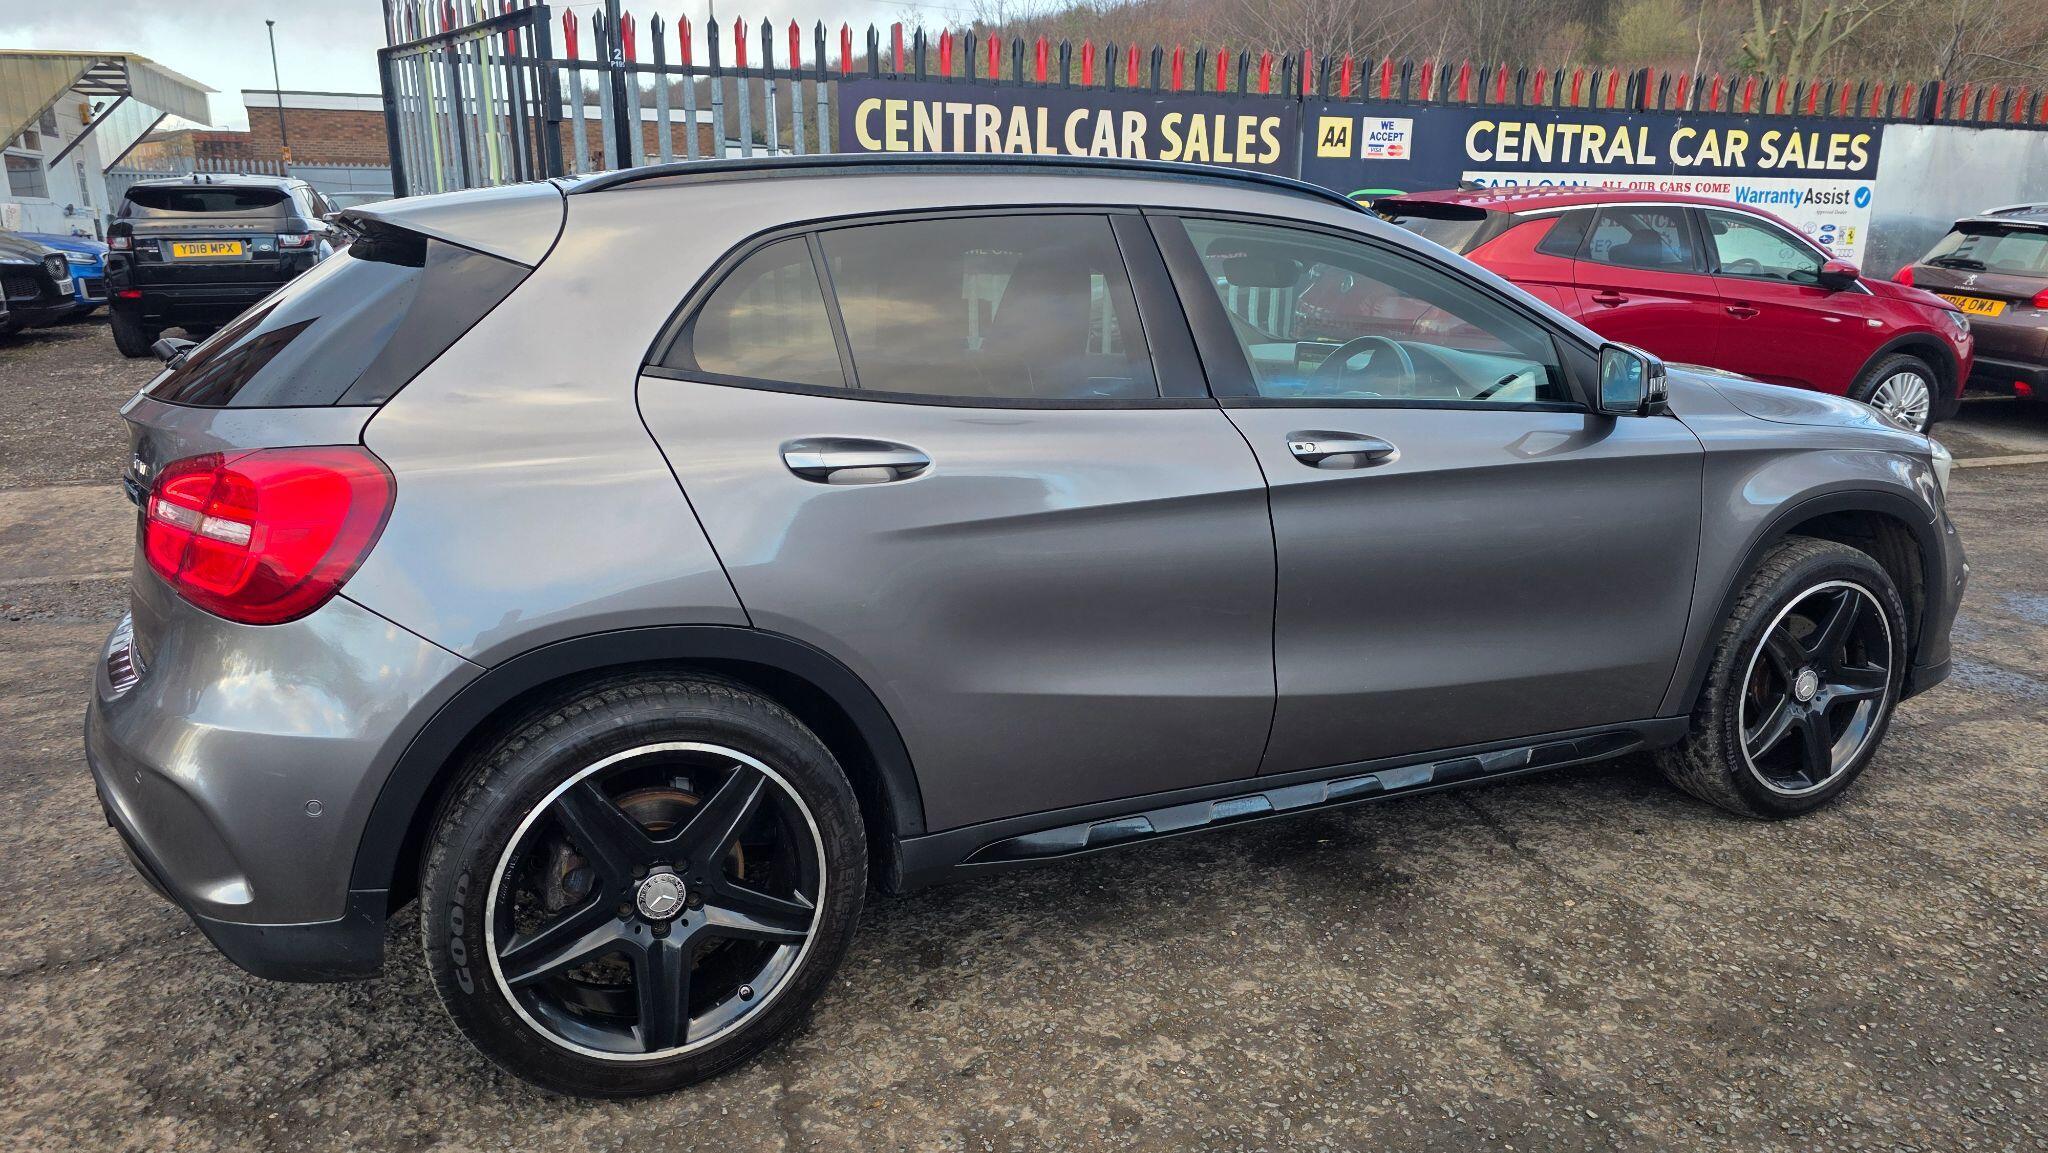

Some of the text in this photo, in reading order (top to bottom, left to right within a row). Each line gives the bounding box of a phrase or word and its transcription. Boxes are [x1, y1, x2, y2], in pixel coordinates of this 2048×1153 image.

[613, 48, 622, 60] 2
[855, 98, 1281, 165] CENTRAL CAR SALES
[1381, 121, 1395, 131] WE
[1322, 126, 1347, 148] AA
[1369, 132, 1405, 142] ACCEPT
[1465, 120, 1871, 172] CENTRAL CAR SALES
[1629, 181, 1656, 191] OUR
[1660, 182, 1692, 193] CARS
[1695, 182, 1731, 193] COME
[180, 244, 207, 254] YD18
[1968, 299, 1996, 313] OWA
